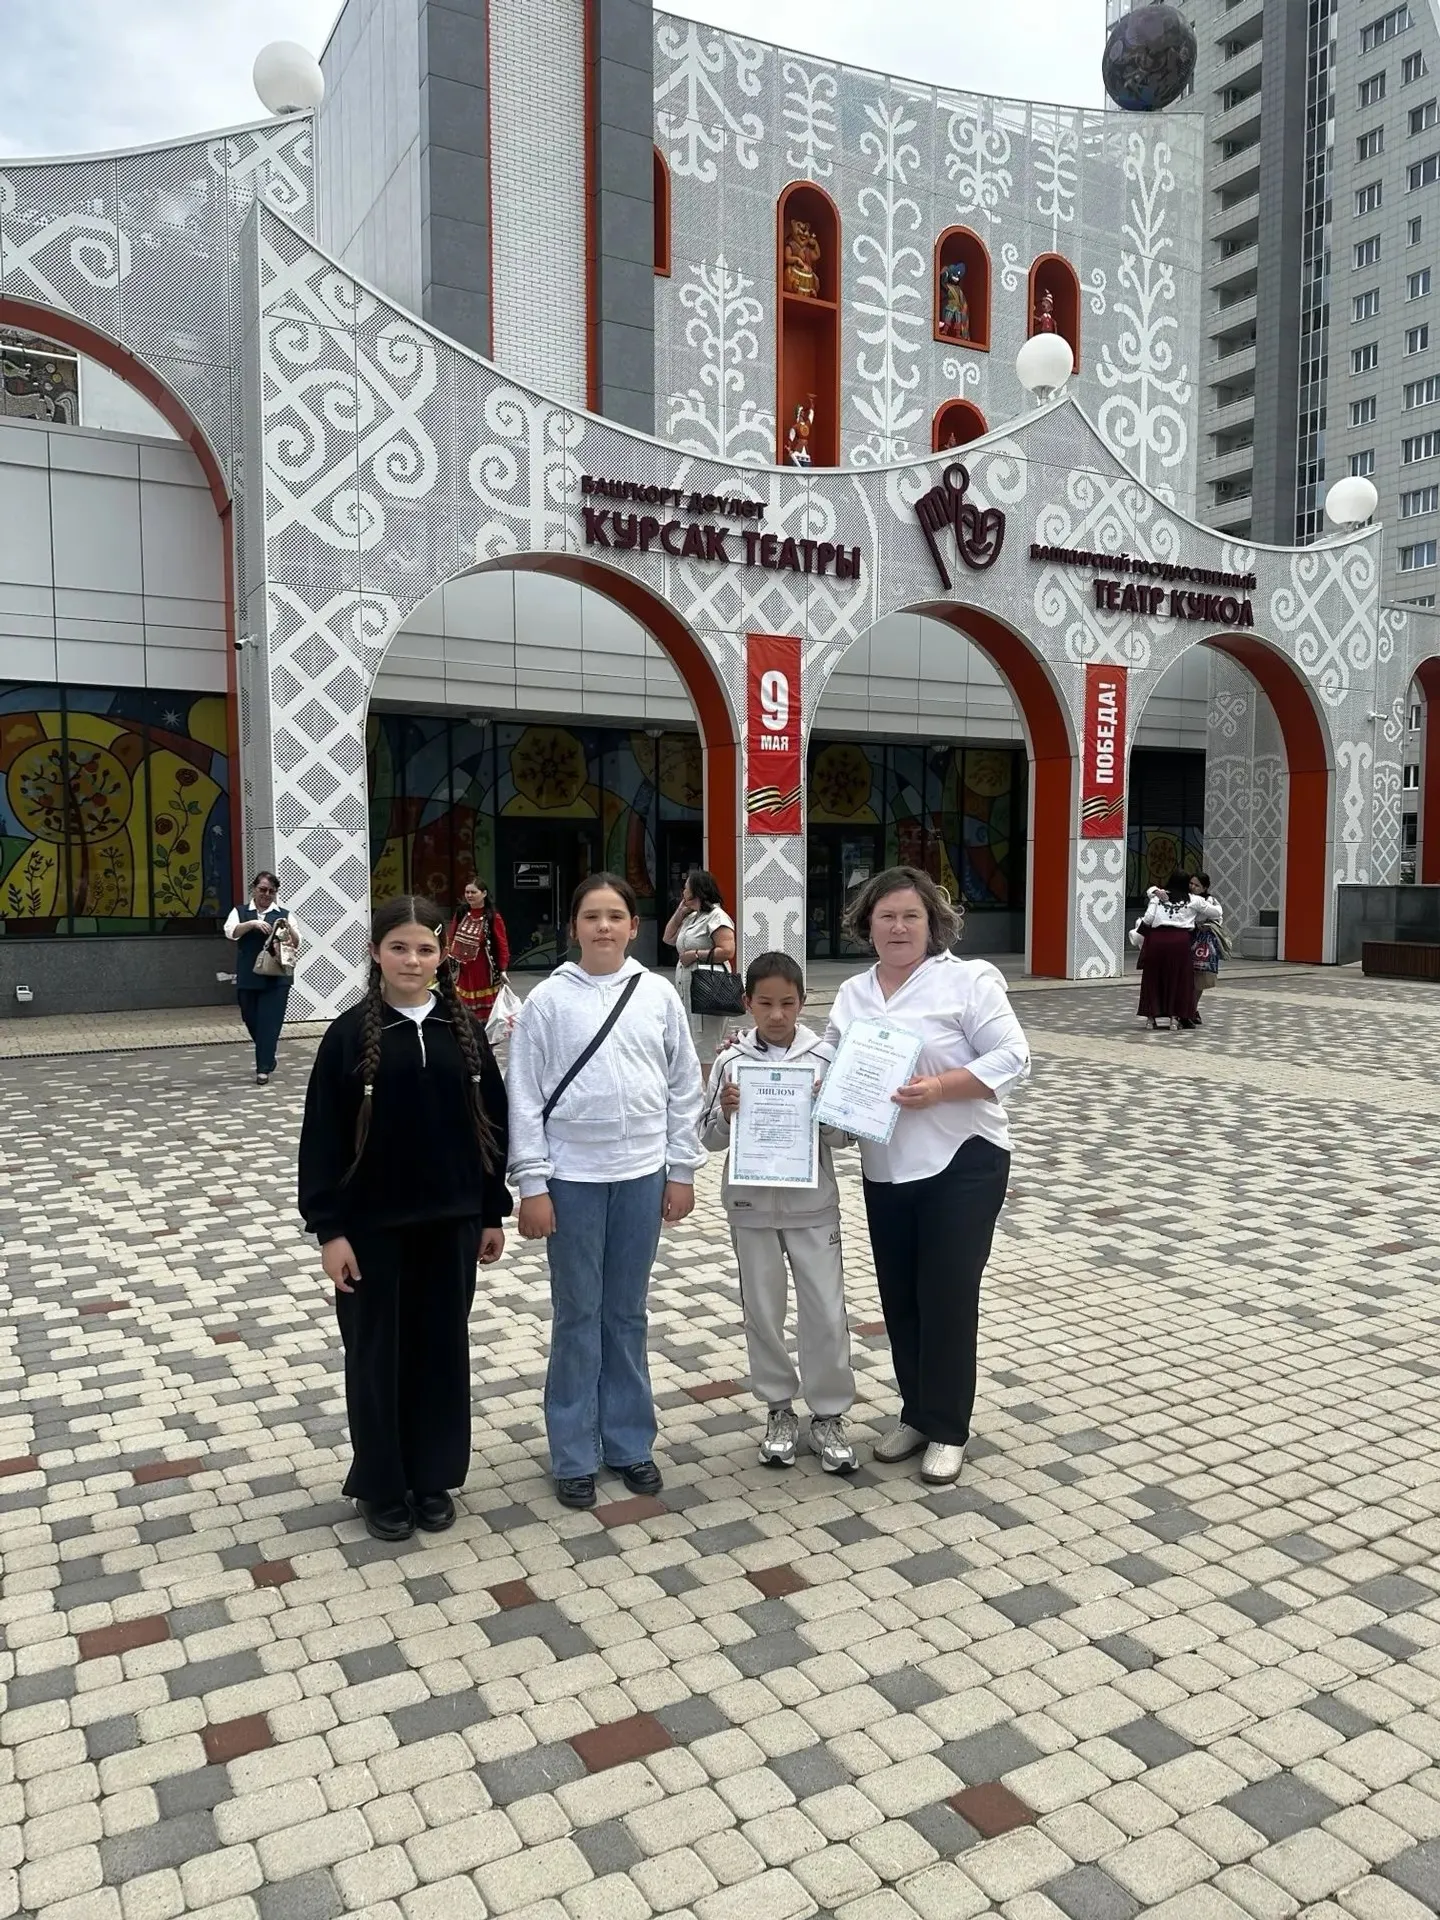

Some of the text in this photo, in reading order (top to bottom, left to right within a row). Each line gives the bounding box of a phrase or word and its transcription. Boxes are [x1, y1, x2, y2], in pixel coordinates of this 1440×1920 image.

[742, 530, 861, 579] ТЕАТРЫ
[1030, 543, 1257, 590] БАШКИРСКИЙ ГОСУДАРСТВЕННЫЙ
[1093, 579, 1255, 627] ТЕАТР КУКОЛ
[760, 670, 789, 731] 9
[761, 735, 789, 751] МАЯ
[1096, 682, 1118, 784] ПОБЕДА!
[756, 1088, 795, 1096] ДИПЛОМ
